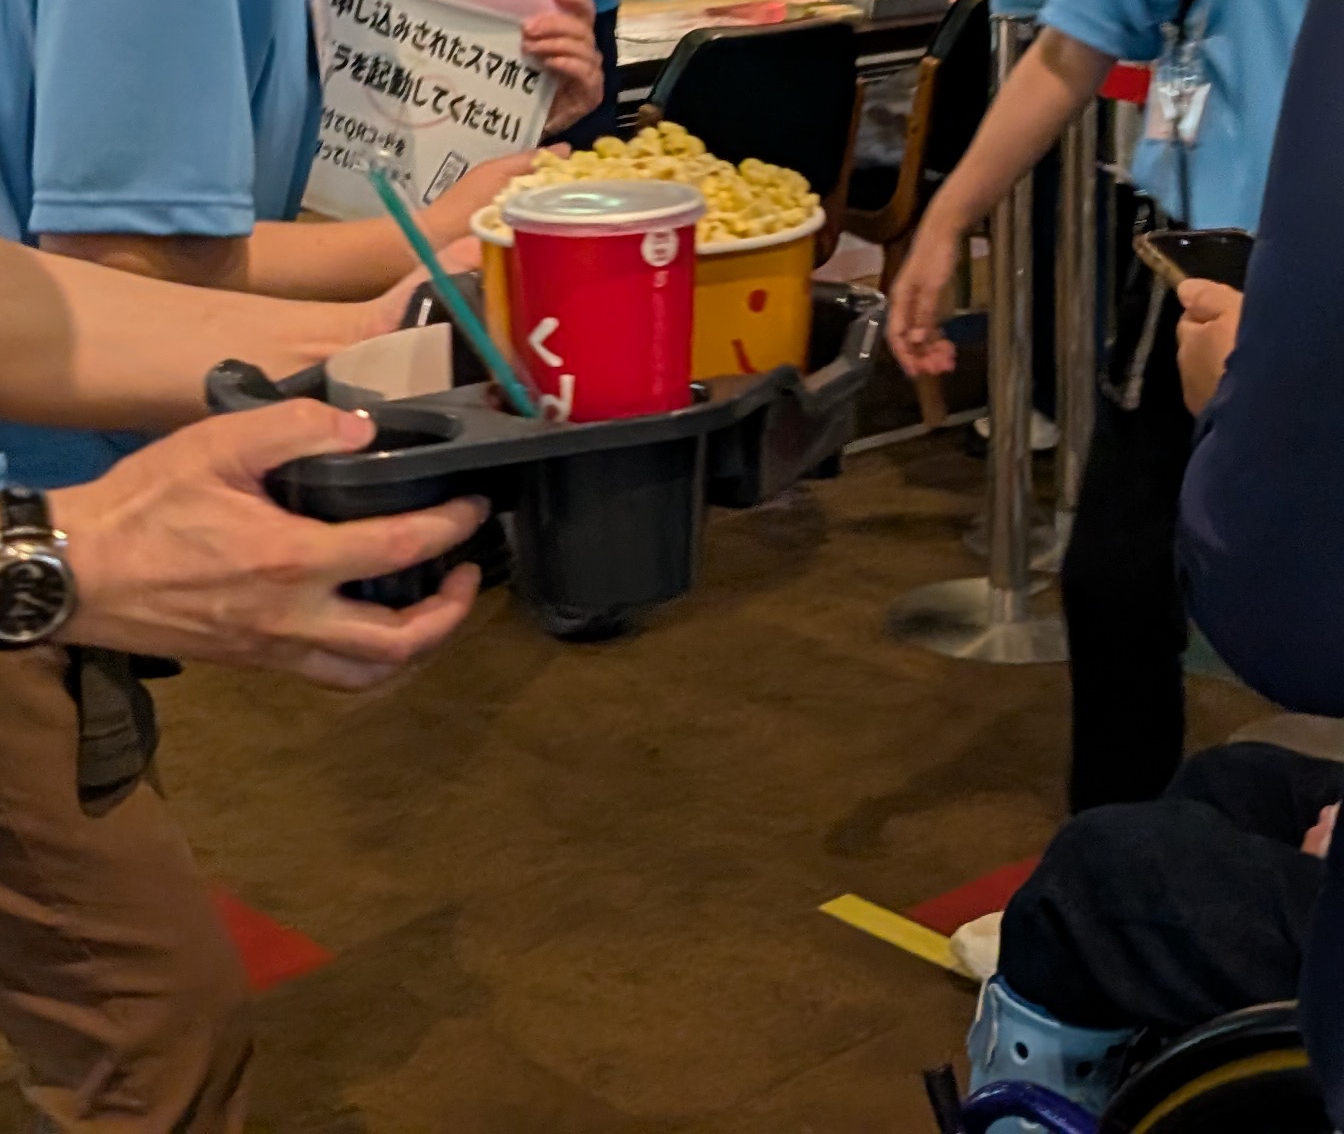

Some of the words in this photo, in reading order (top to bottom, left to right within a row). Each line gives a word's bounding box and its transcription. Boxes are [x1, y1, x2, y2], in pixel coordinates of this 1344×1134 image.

[331, 41, 522, 144] ラを起動してください
